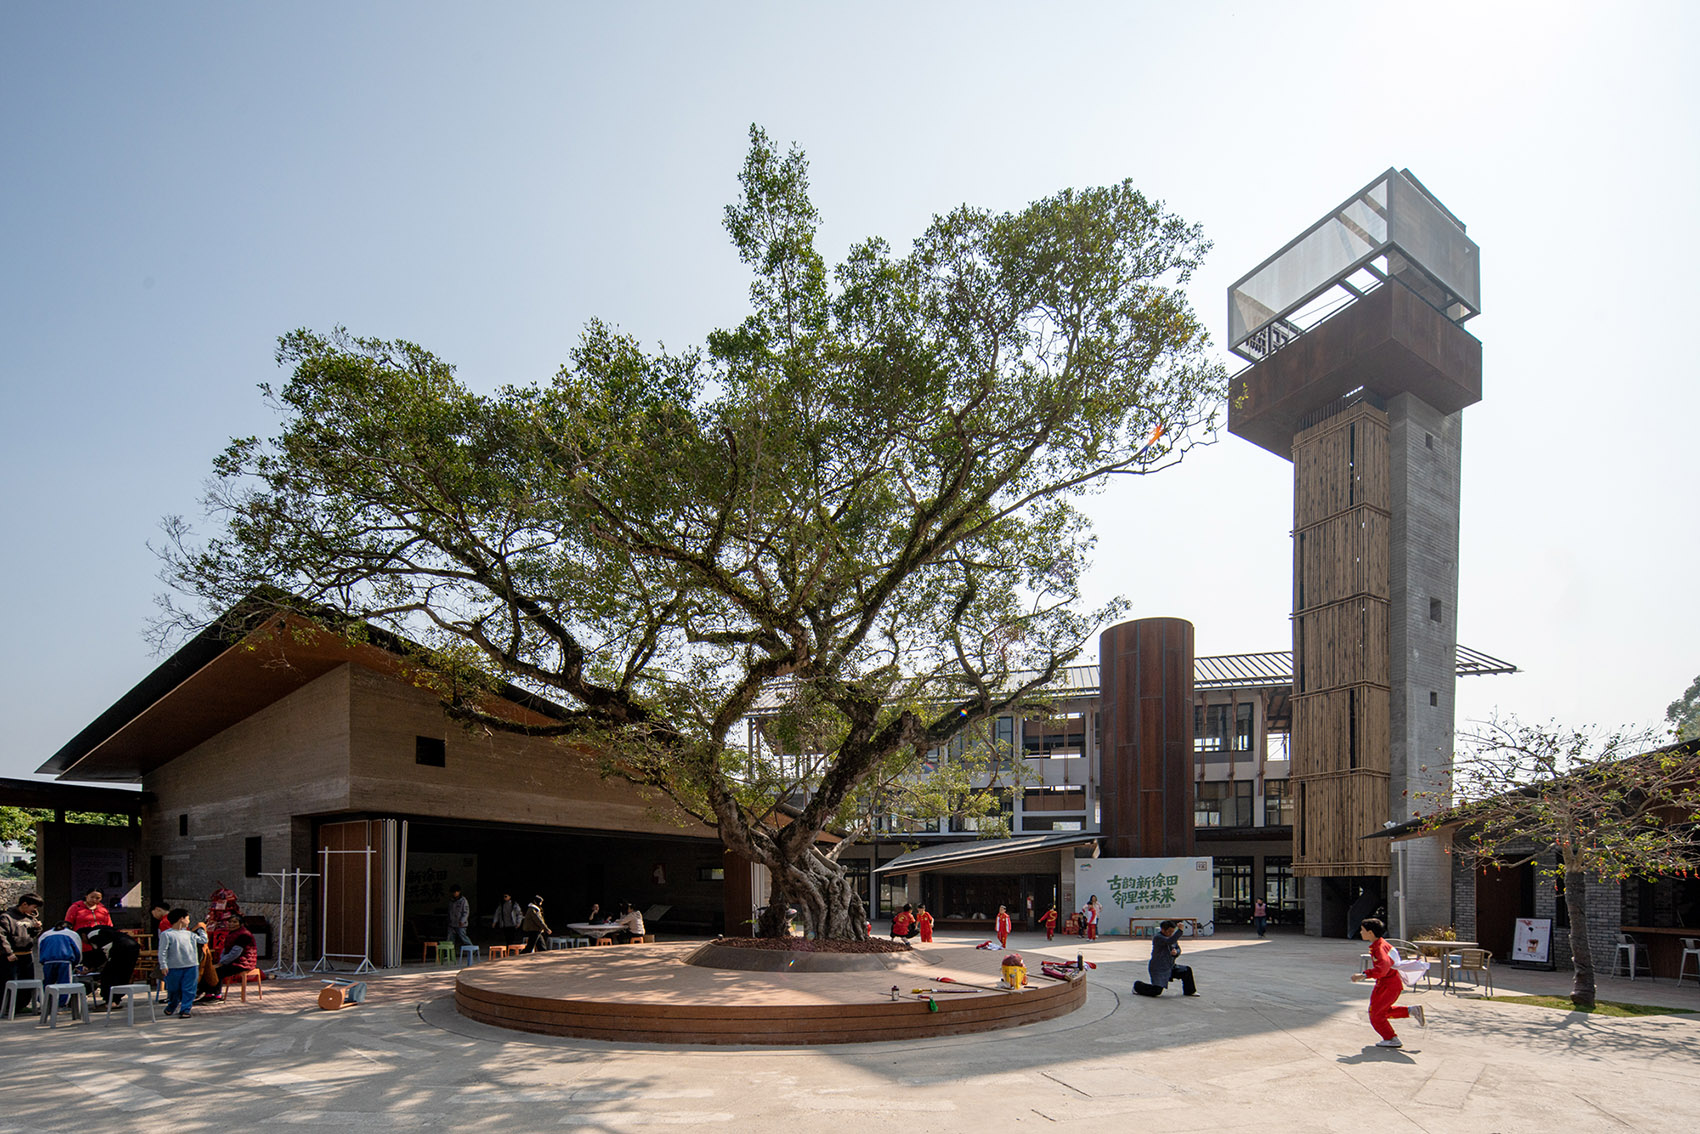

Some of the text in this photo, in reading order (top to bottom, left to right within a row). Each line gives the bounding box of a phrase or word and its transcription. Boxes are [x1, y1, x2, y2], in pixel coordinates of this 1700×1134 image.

[1107, 872, 1178, 890] 古韵新徐田
[1112, 887, 1176, 909] 邻里共未来
